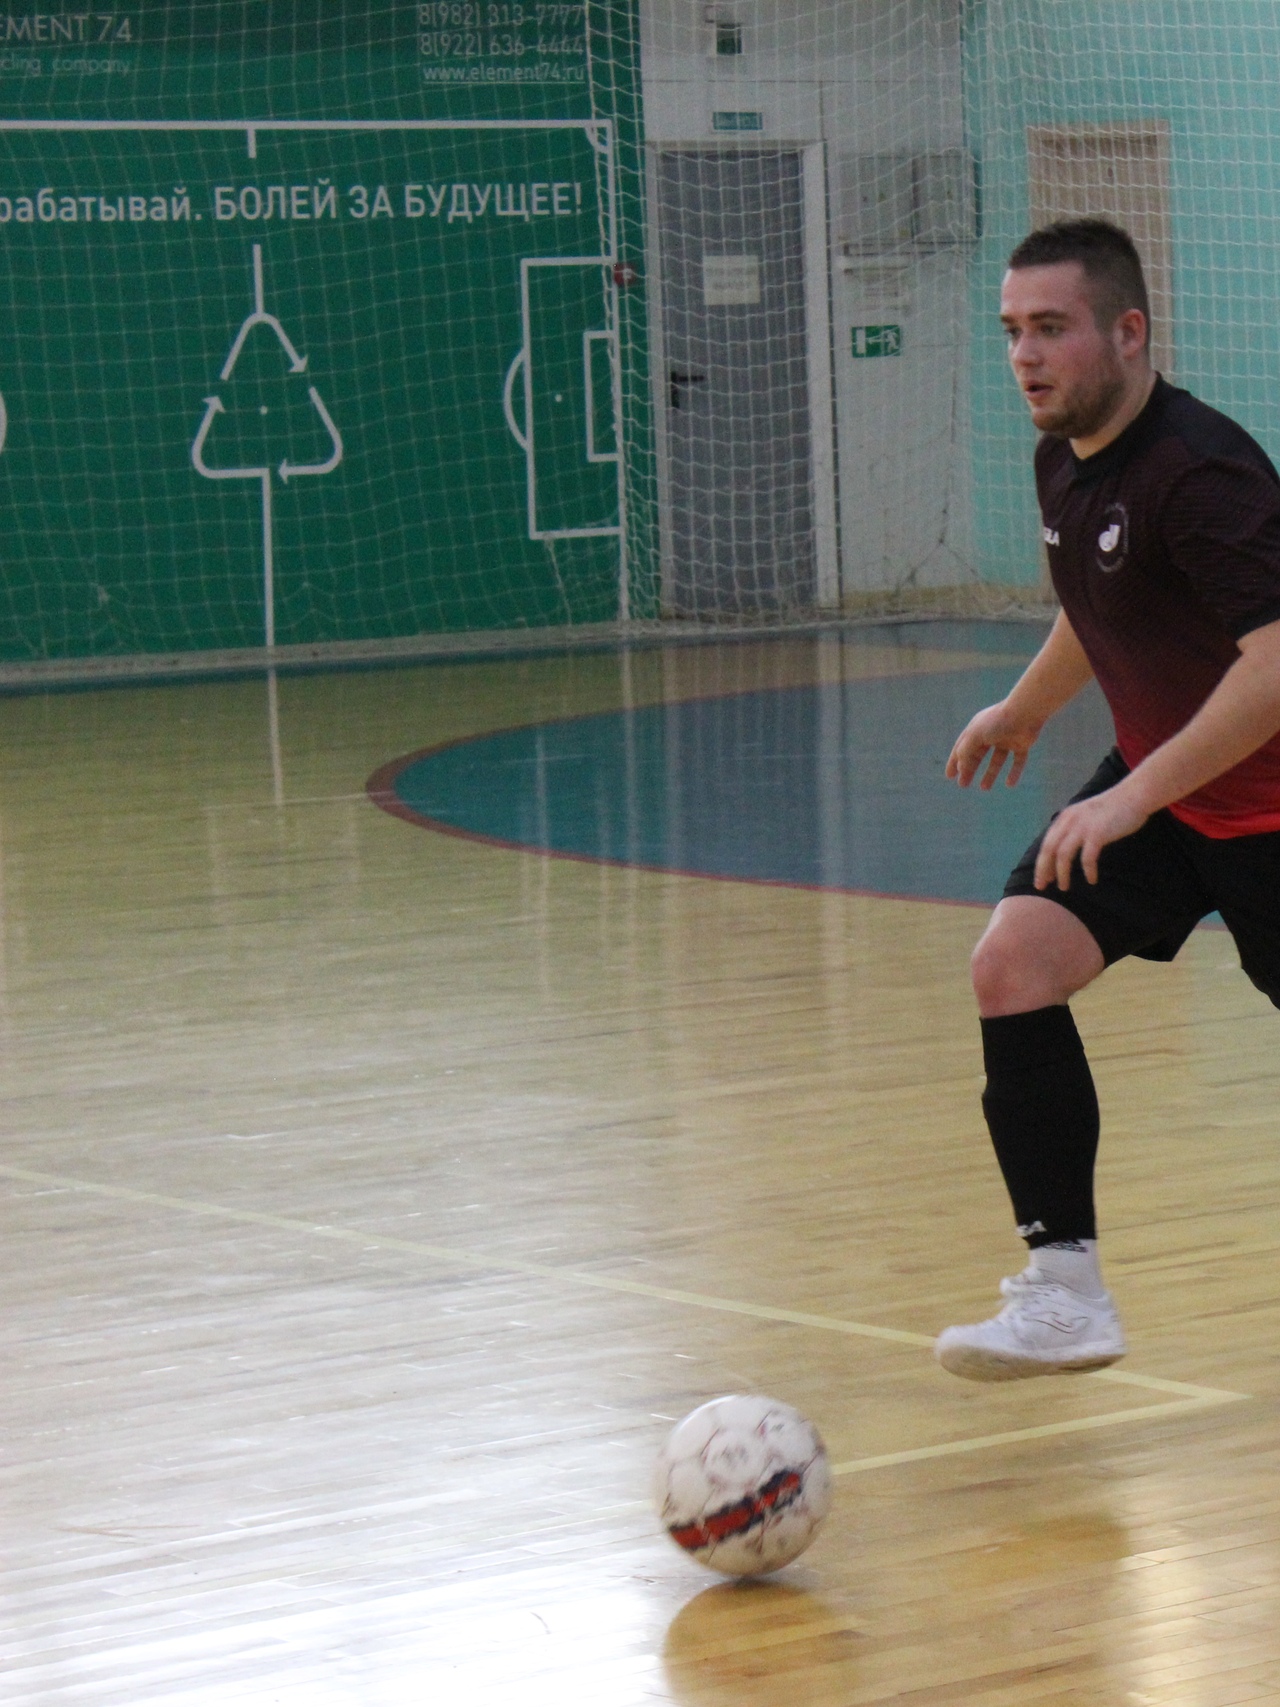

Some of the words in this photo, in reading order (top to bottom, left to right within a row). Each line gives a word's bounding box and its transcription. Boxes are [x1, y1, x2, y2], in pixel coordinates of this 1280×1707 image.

[97, 16, 133, 42] 74
[0, 53, 41, 77] cling
[52, 59, 130, 76] company
[422, 62, 585, 81] www.element74.ru
[214, 178, 335, 222] БОЛЕЙ
[348, 185, 395, 220] ЗА
[404, 182, 584, 224] БУДУЩЕЕ!
